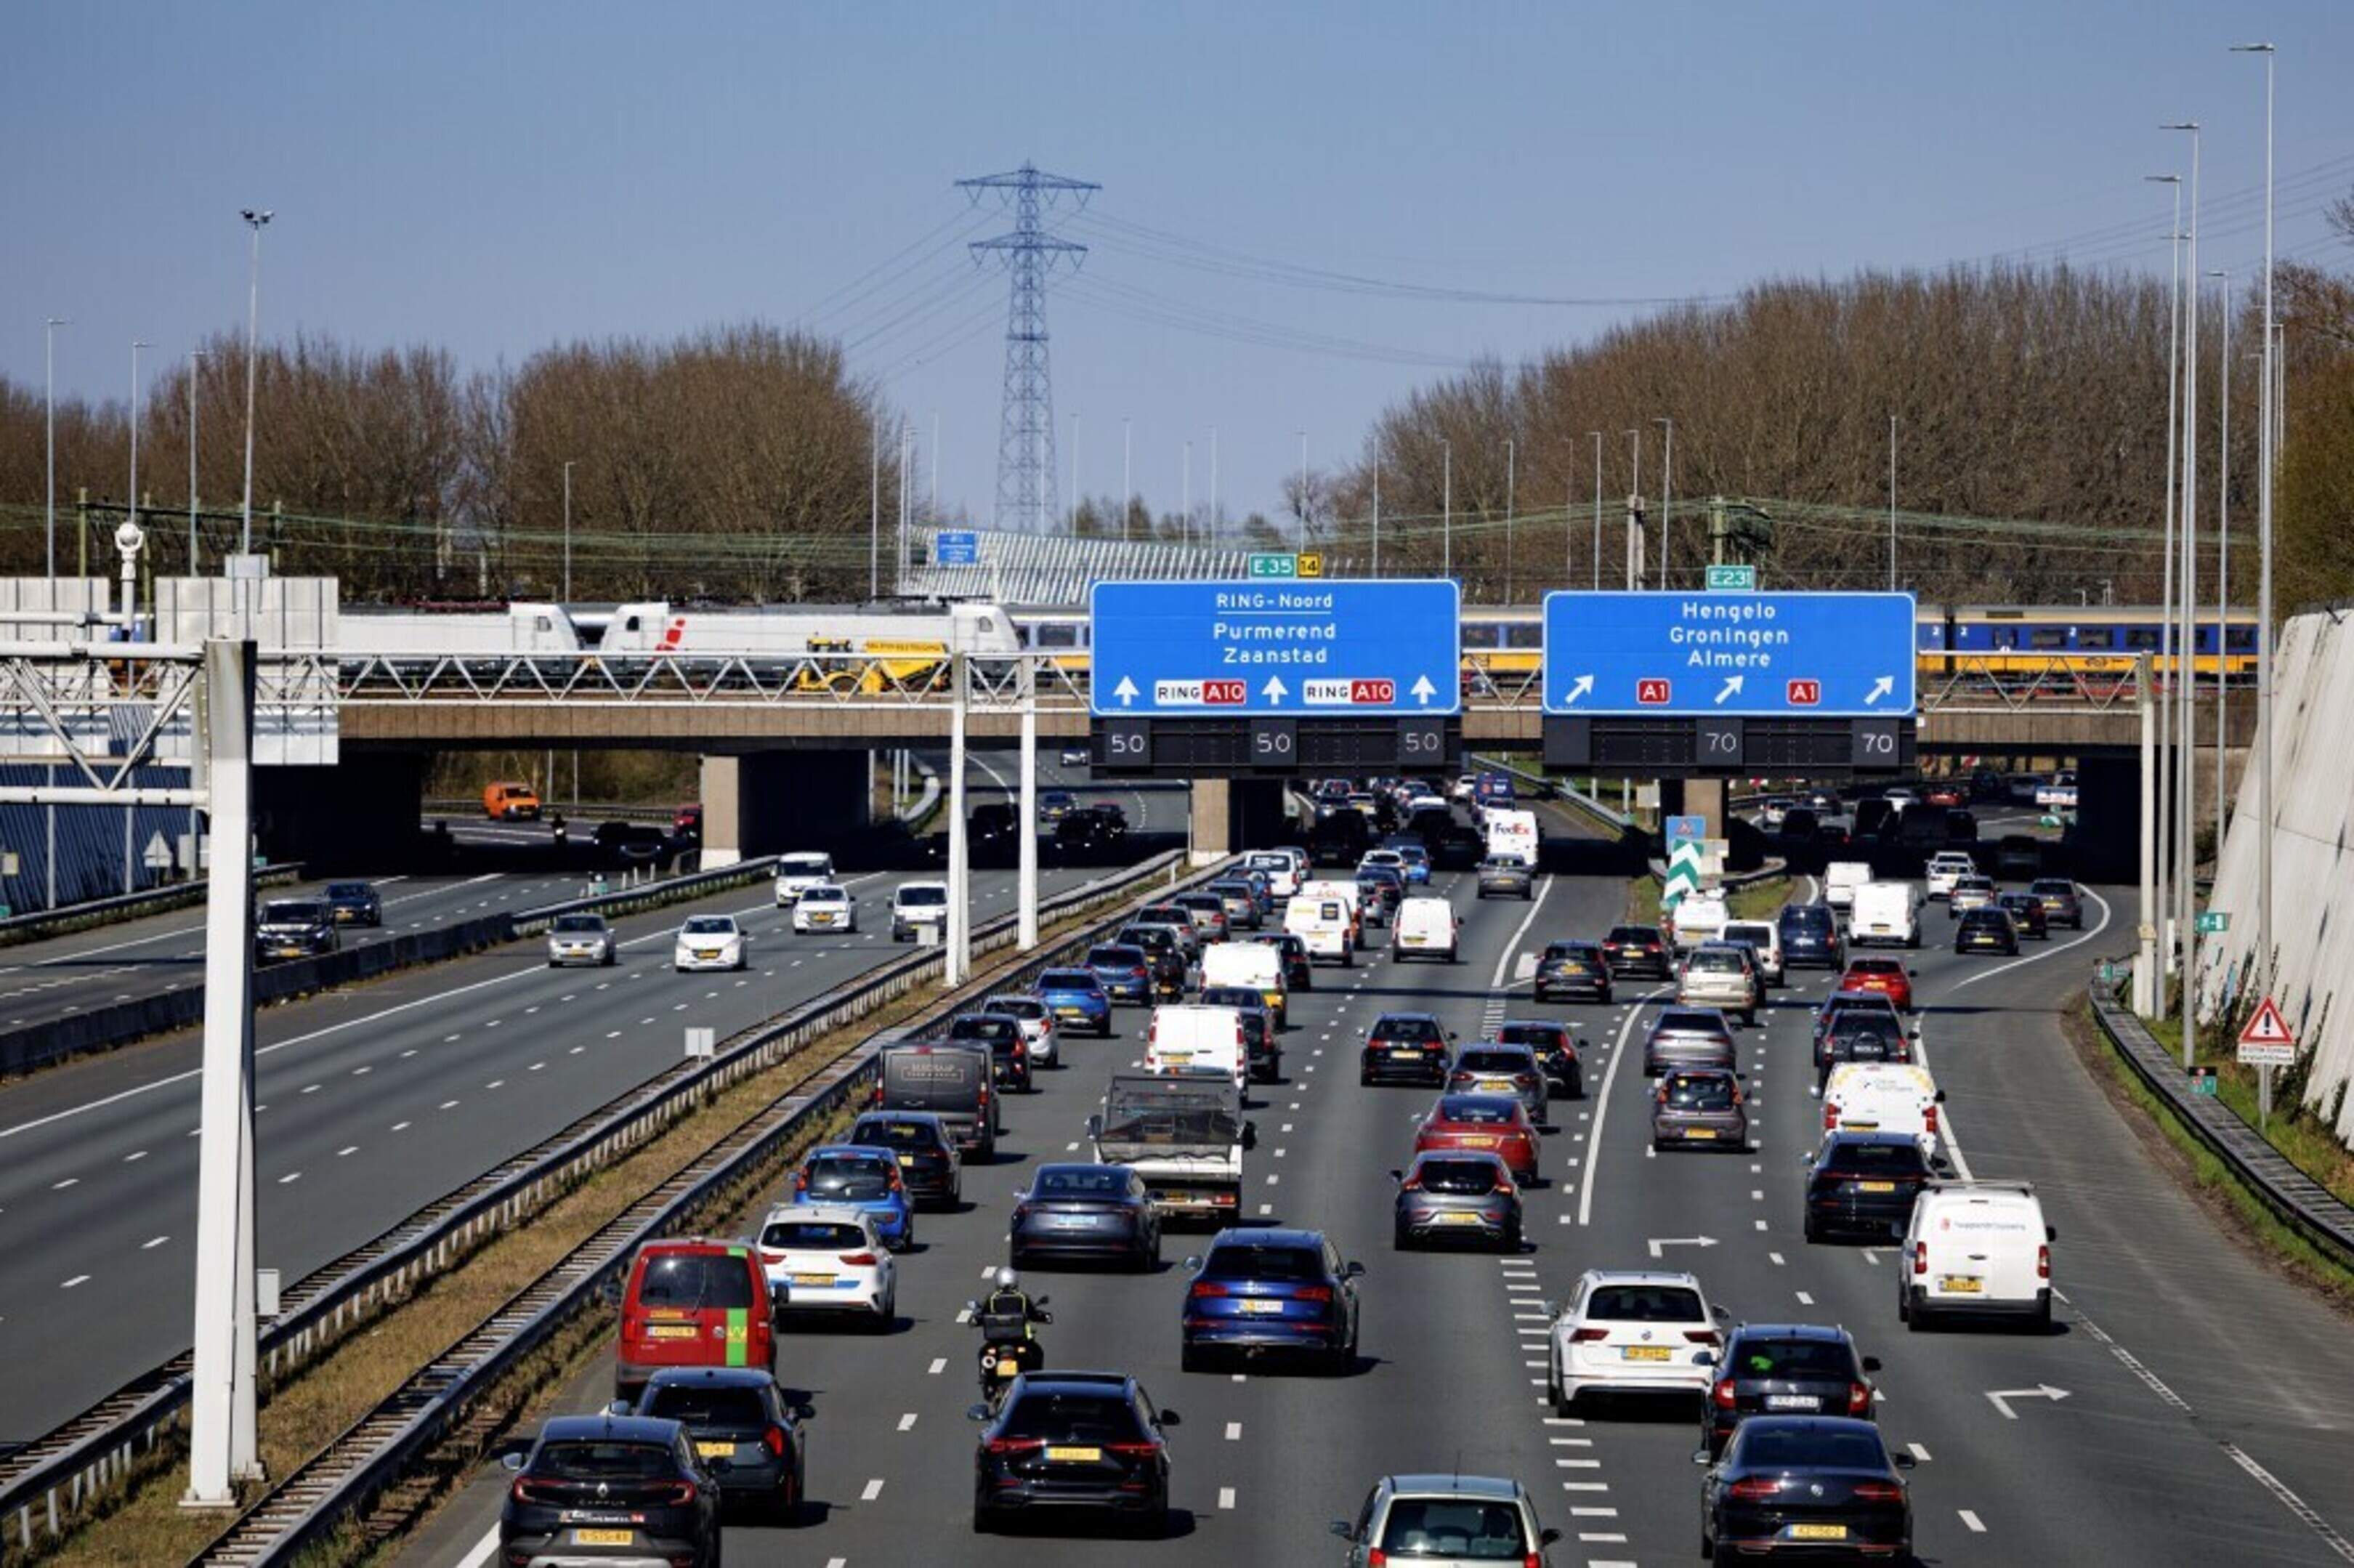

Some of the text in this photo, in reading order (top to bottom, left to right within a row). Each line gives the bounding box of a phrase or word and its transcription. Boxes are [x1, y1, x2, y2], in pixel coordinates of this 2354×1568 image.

[1216, 593, 1332, 608] RING-Noord
[1683, 602, 1776, 621] Hengelo
[1213, 623, 1335, 639] Purmerend
[1670, 627, 1788, 647] Groningen
[1223, 647, 1327, 663] Zaanstad
[1688, 650, 1771, 667] Almere
[1157, 684, 1244, 699] RING A10
[1307, 684, 1393, 699] RING A10
[1643, 684, 1667, 699] A1
[1792, 684, 1816, 699] A1
[1112, 734, 1145, 753] 50
[1257, 734, 1290, 753] 50
[1406, 732, 1439, 751] 50
[1707, 733, 1736, 752] 70
[1862, 733, 1893, 752] 70
